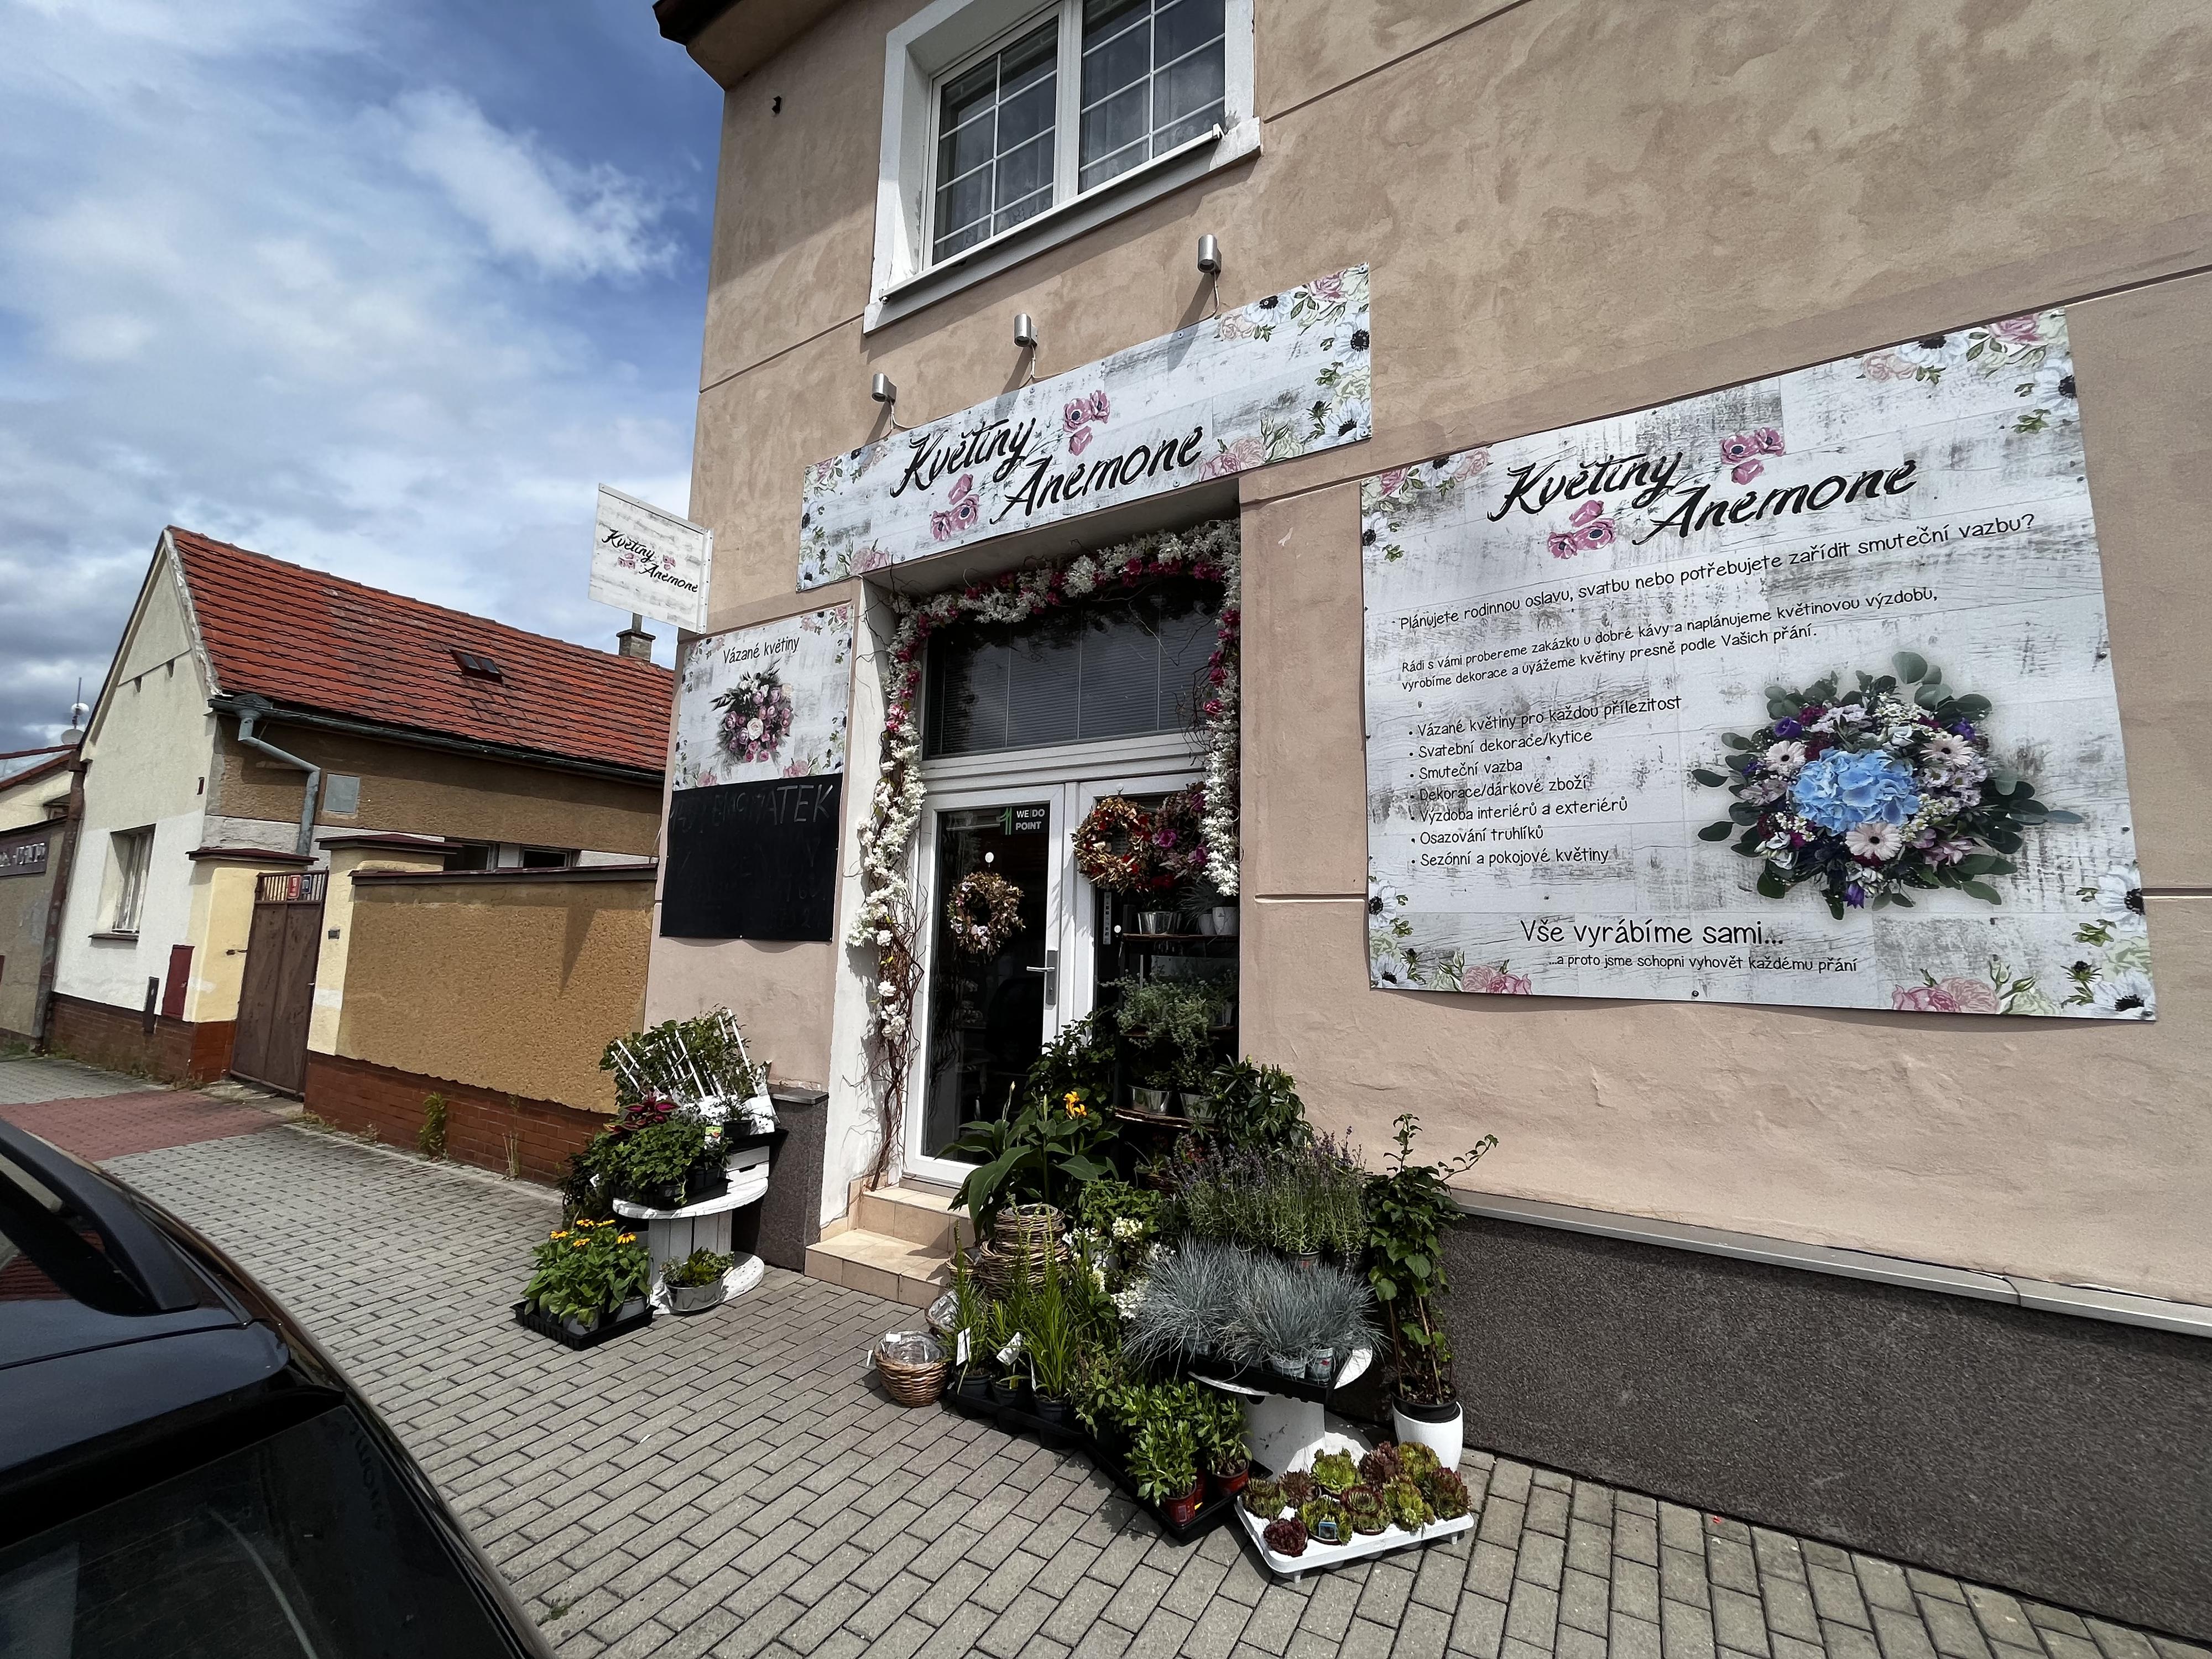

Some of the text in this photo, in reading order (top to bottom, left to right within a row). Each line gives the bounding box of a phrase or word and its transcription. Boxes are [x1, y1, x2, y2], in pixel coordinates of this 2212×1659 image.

[890, 419, 1203, 525] Květiny Anemone
[1487, 452, 1917, 545] Květiny Anemone
[602, 529, 698, 592] Květiny Anemone
[1400, 513, 2034, 630] Plánujete rodinnou oslavu, svatbu nebo potřebujete zařídit smuteční vazbu?
[1402, 588, 1937, 672] Rádi s vámi probereme zakázku u dobré kávy a naplánujeme květinovou výzdobu,
[723, 635, 800, 664] Vázané květiny
[1402, 676, 1452, 691] vyrobíme
[1456, 668, 1507, 684] dekorace
[1522, 658, 1575, 675] uyážeme
[1580, 650, 1625, 664] květiny
[1630, 641, 1676, 661] presně
[1681, 637, 1715, 655] podle
[1721, 631, 1768, 648] Vašich
[1773, 623, 1817, 643] přání.
[1417, 696, 1682, 737] Vázané květiny pro každou přílezitost
[1418, 730, 1593, 759] Svatební dekorace/kytice
[1419, 761, 1522, 780] Smuteční vazba
[1421, 778, 1588, 802] Dekorace/dárkové zboží
[1421, 796, 1627, 825] Výzdoba interiérů a exteriérů
[1015, 821, 1042, 830] POINT
[1421, 825, 1543, 844] Osazování truhlíků
[1421, 847, 1608, 867] Sezónní a pokojové květiny
[1521, 917, 1783, 948] Vše vyrábíme sami...
[1550, 955, 1857, 973] ...a proto jsme schopni vyhovět každému přání
